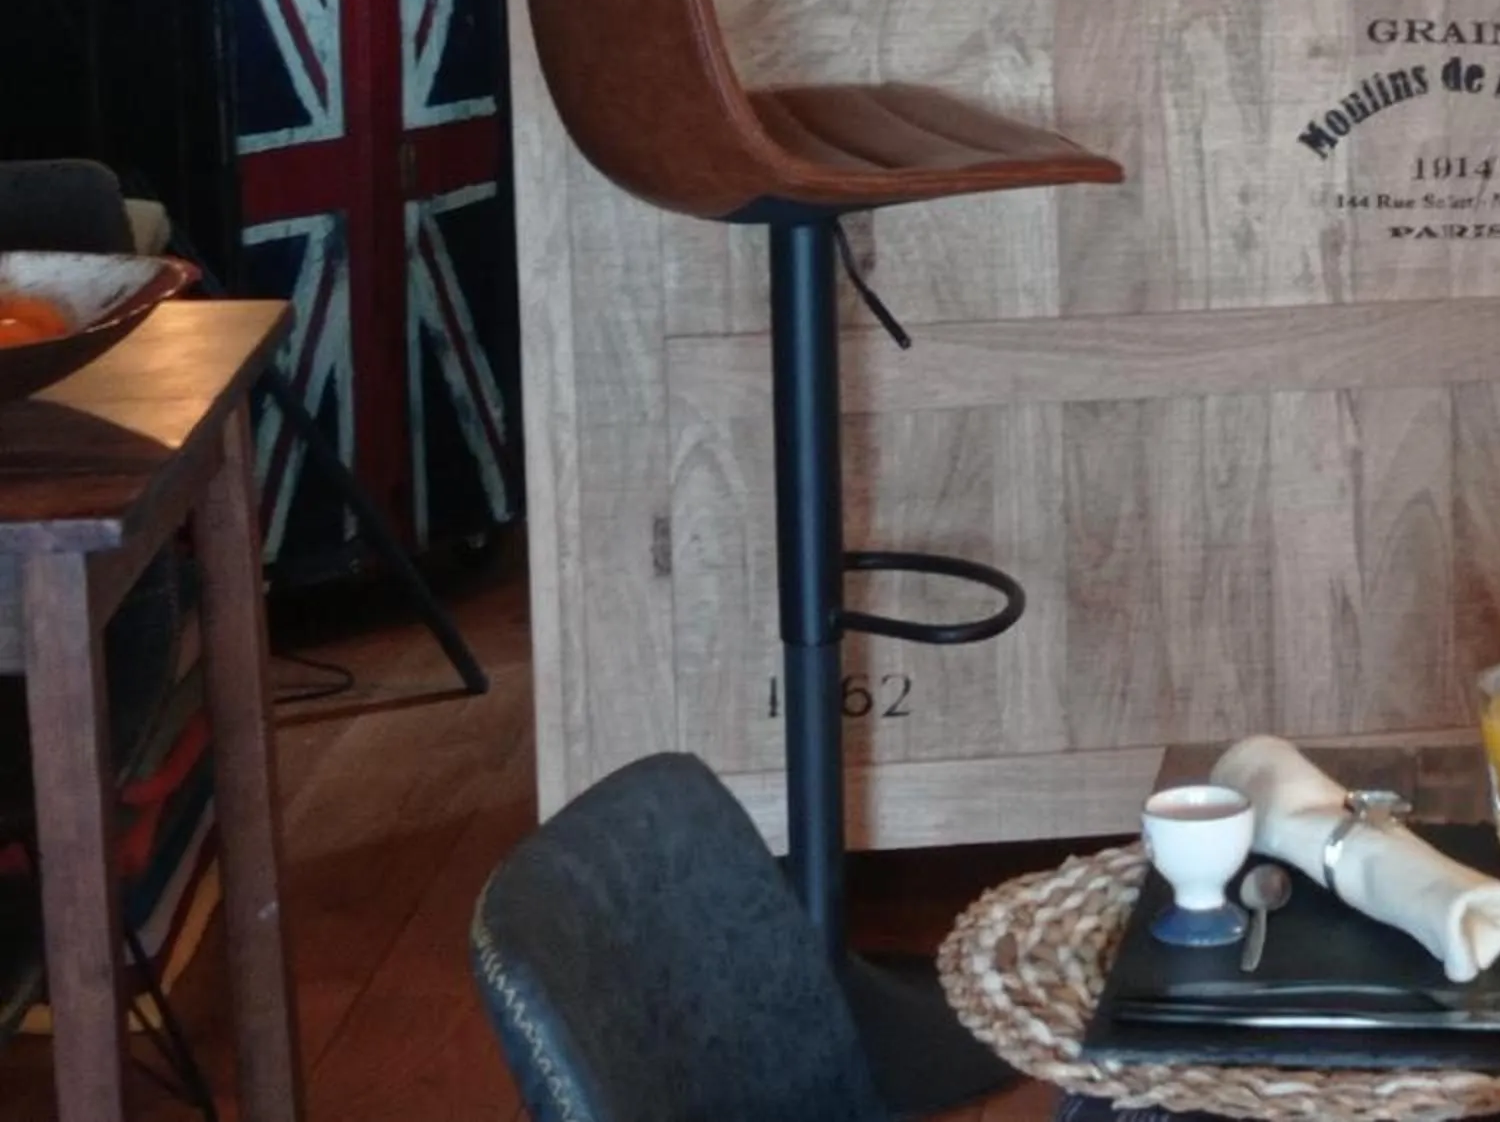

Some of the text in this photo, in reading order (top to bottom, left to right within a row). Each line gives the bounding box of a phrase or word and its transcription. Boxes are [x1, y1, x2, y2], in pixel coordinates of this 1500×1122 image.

[1298, 64, 1429, 160] Moulins
[1441, 56, 1485, 93] de
[1411, 155, 1495, 180] 1914
[1376, 193, 1416, 209] Rue
[767, 673, 912, 719] 162
